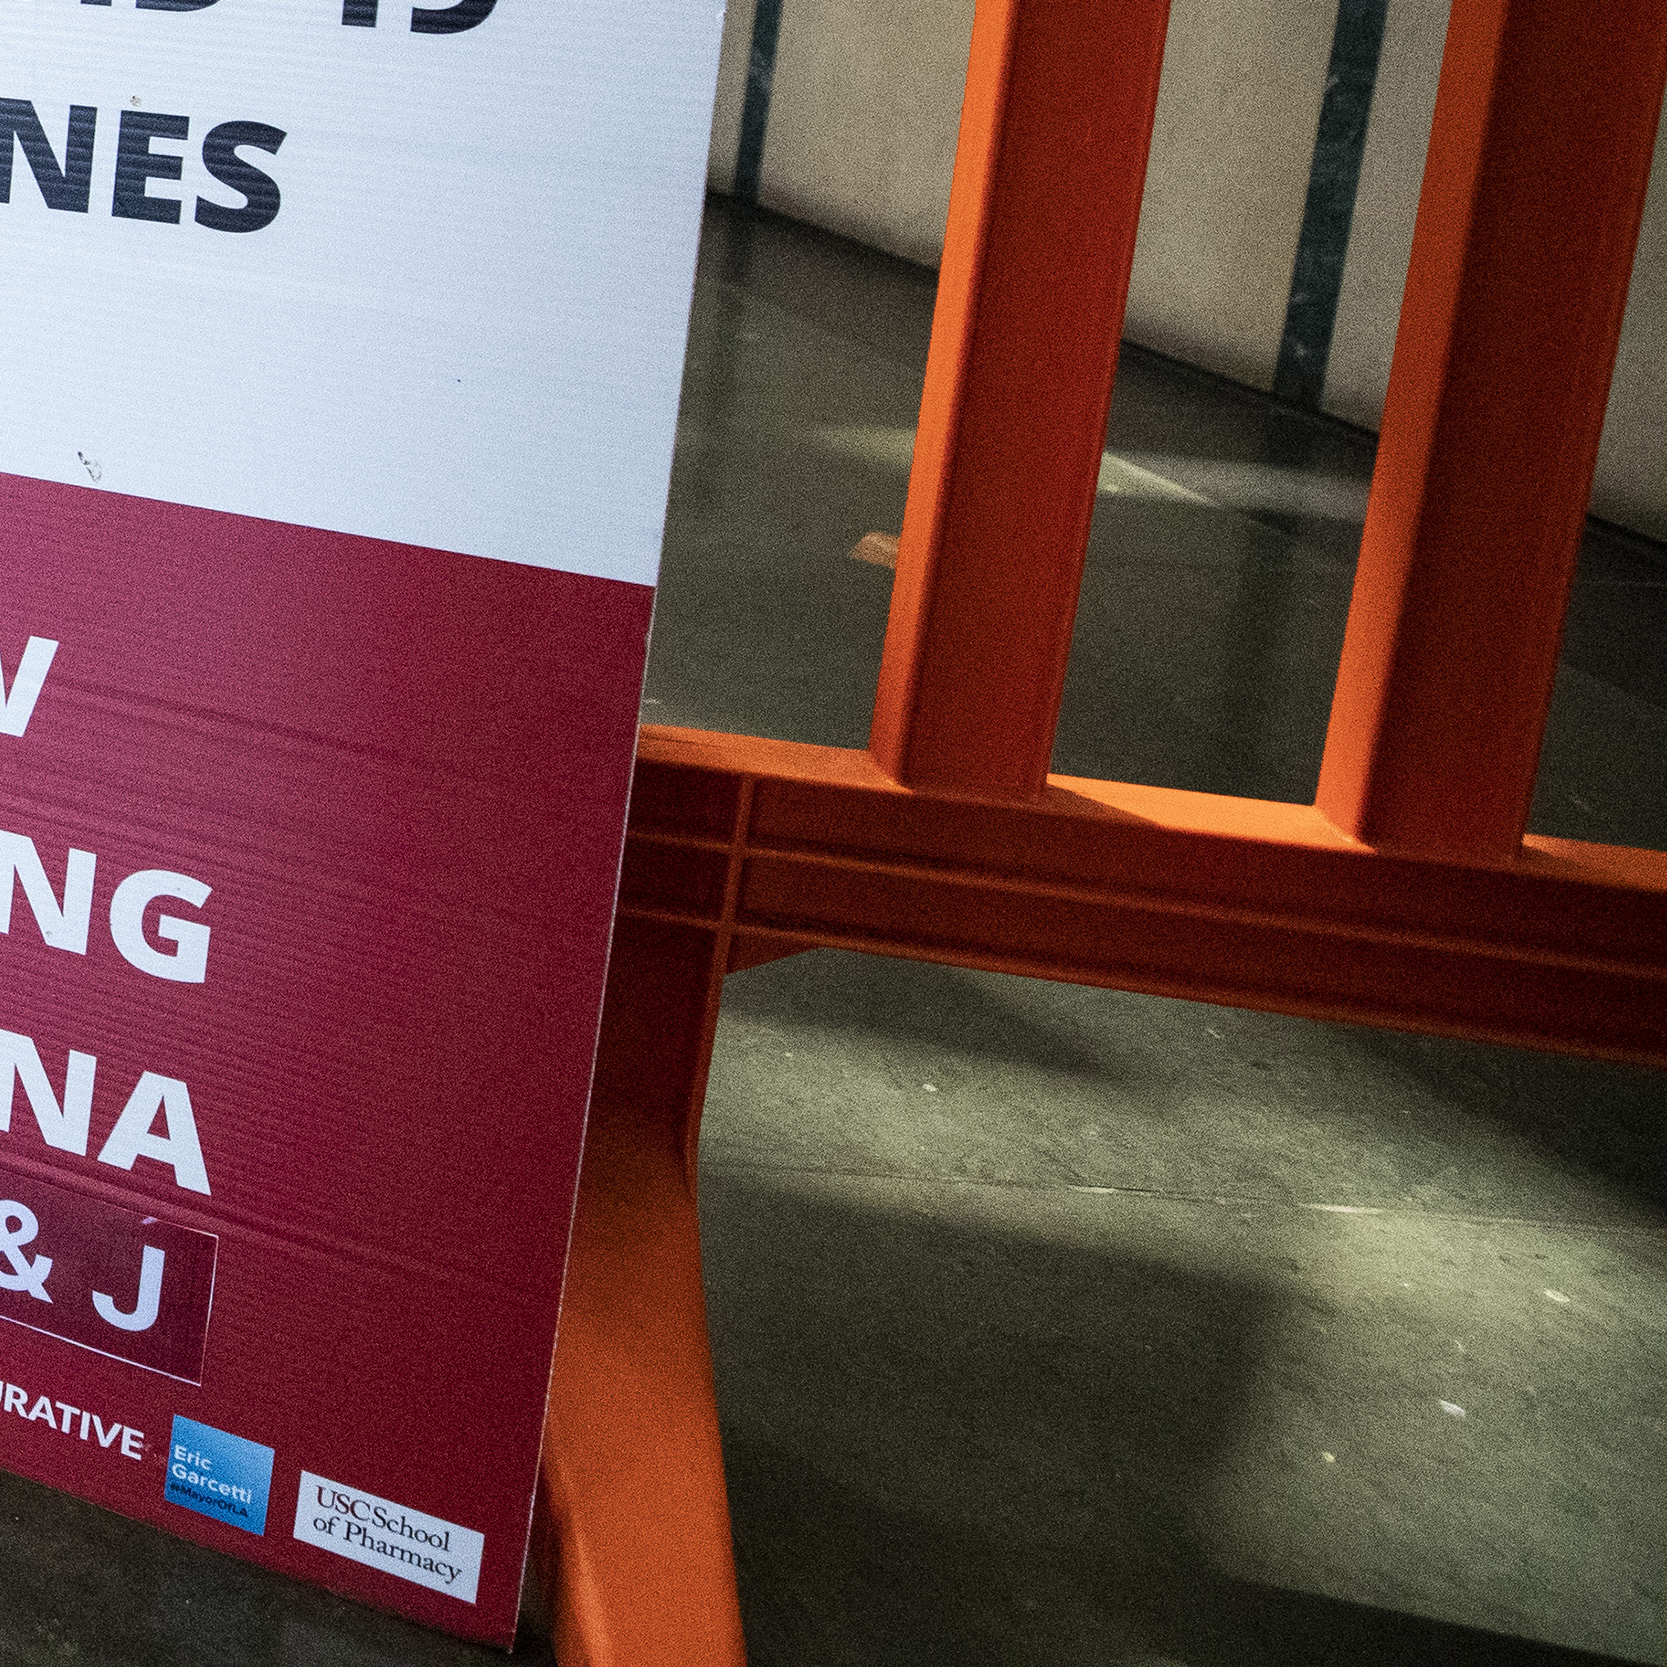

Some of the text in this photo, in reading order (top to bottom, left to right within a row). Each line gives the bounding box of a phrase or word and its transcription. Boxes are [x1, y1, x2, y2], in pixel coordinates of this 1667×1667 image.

[92, 1245, 165, 1331] J
[171, 1463, 252, 1504] Garcetti
[174, 1444, 212, 1470] Eric
[313, 1516, 463, 1584] of Pharmacy
